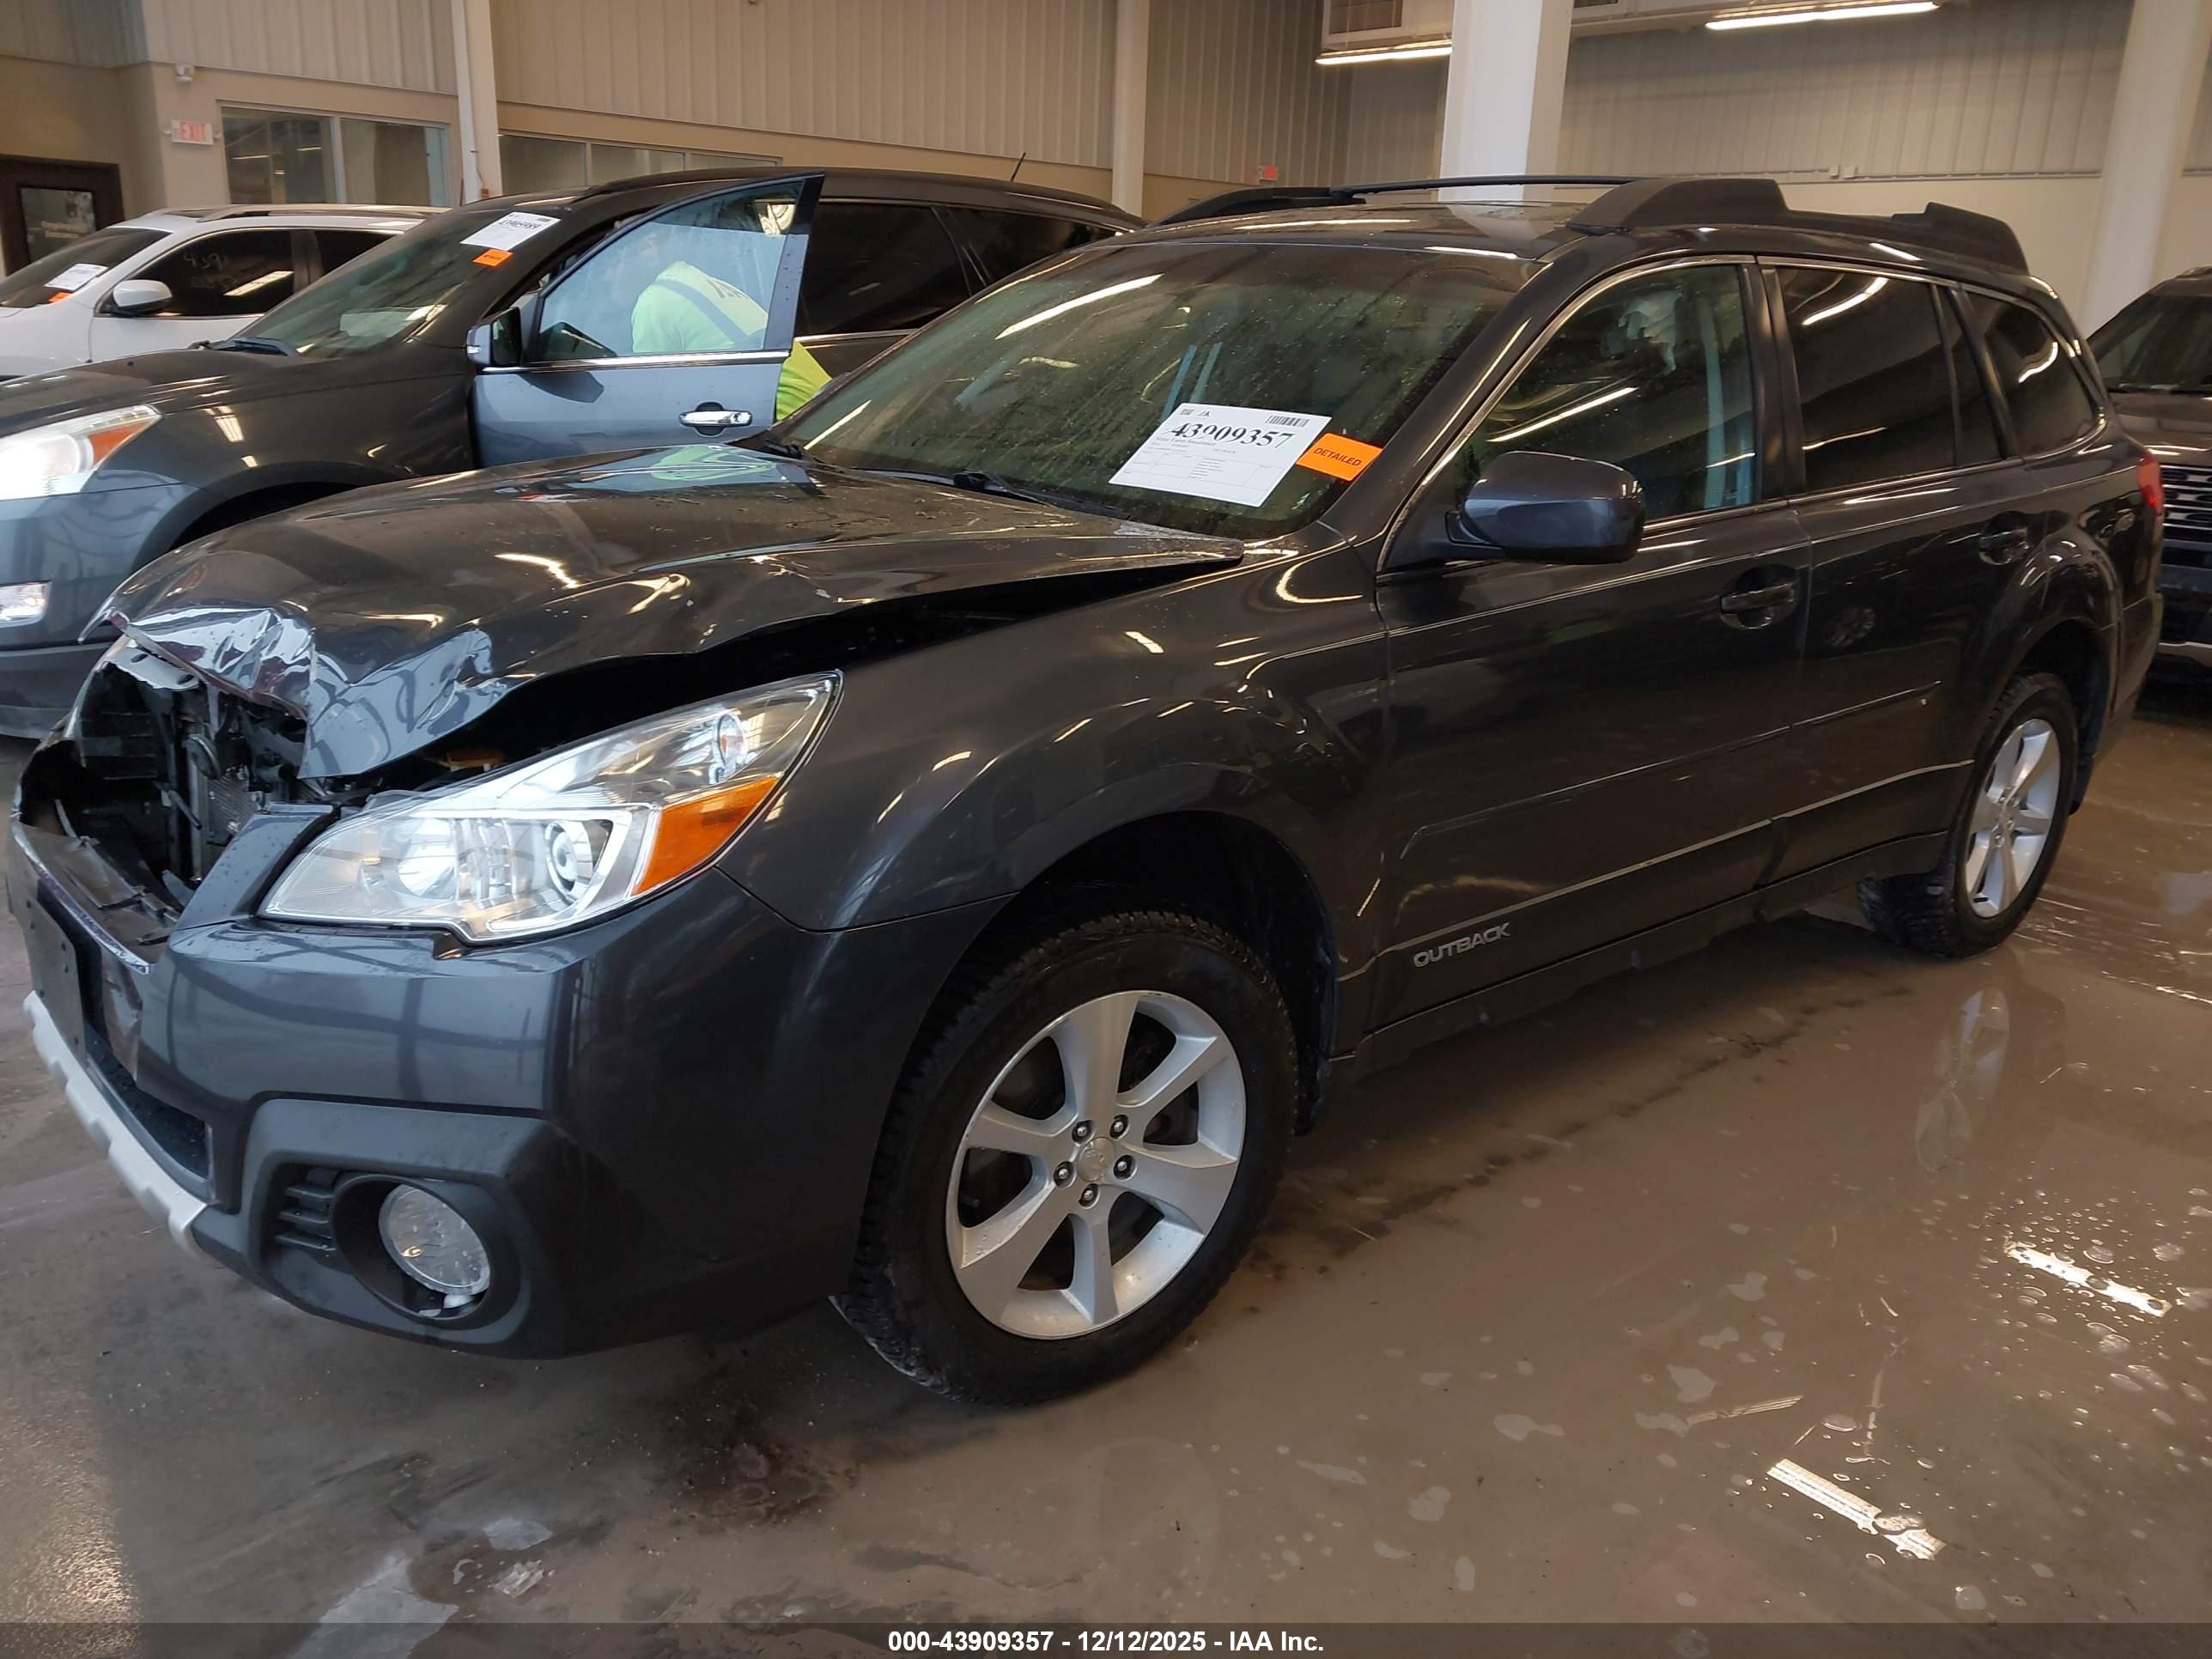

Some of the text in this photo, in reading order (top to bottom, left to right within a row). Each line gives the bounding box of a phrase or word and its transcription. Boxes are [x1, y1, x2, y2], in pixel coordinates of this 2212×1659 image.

[1169, 422, 1297, 448] 43909357
[1314, 447, 1362, 466] DETAILED
[1413, 921, 1511, 968] OUTBACK
